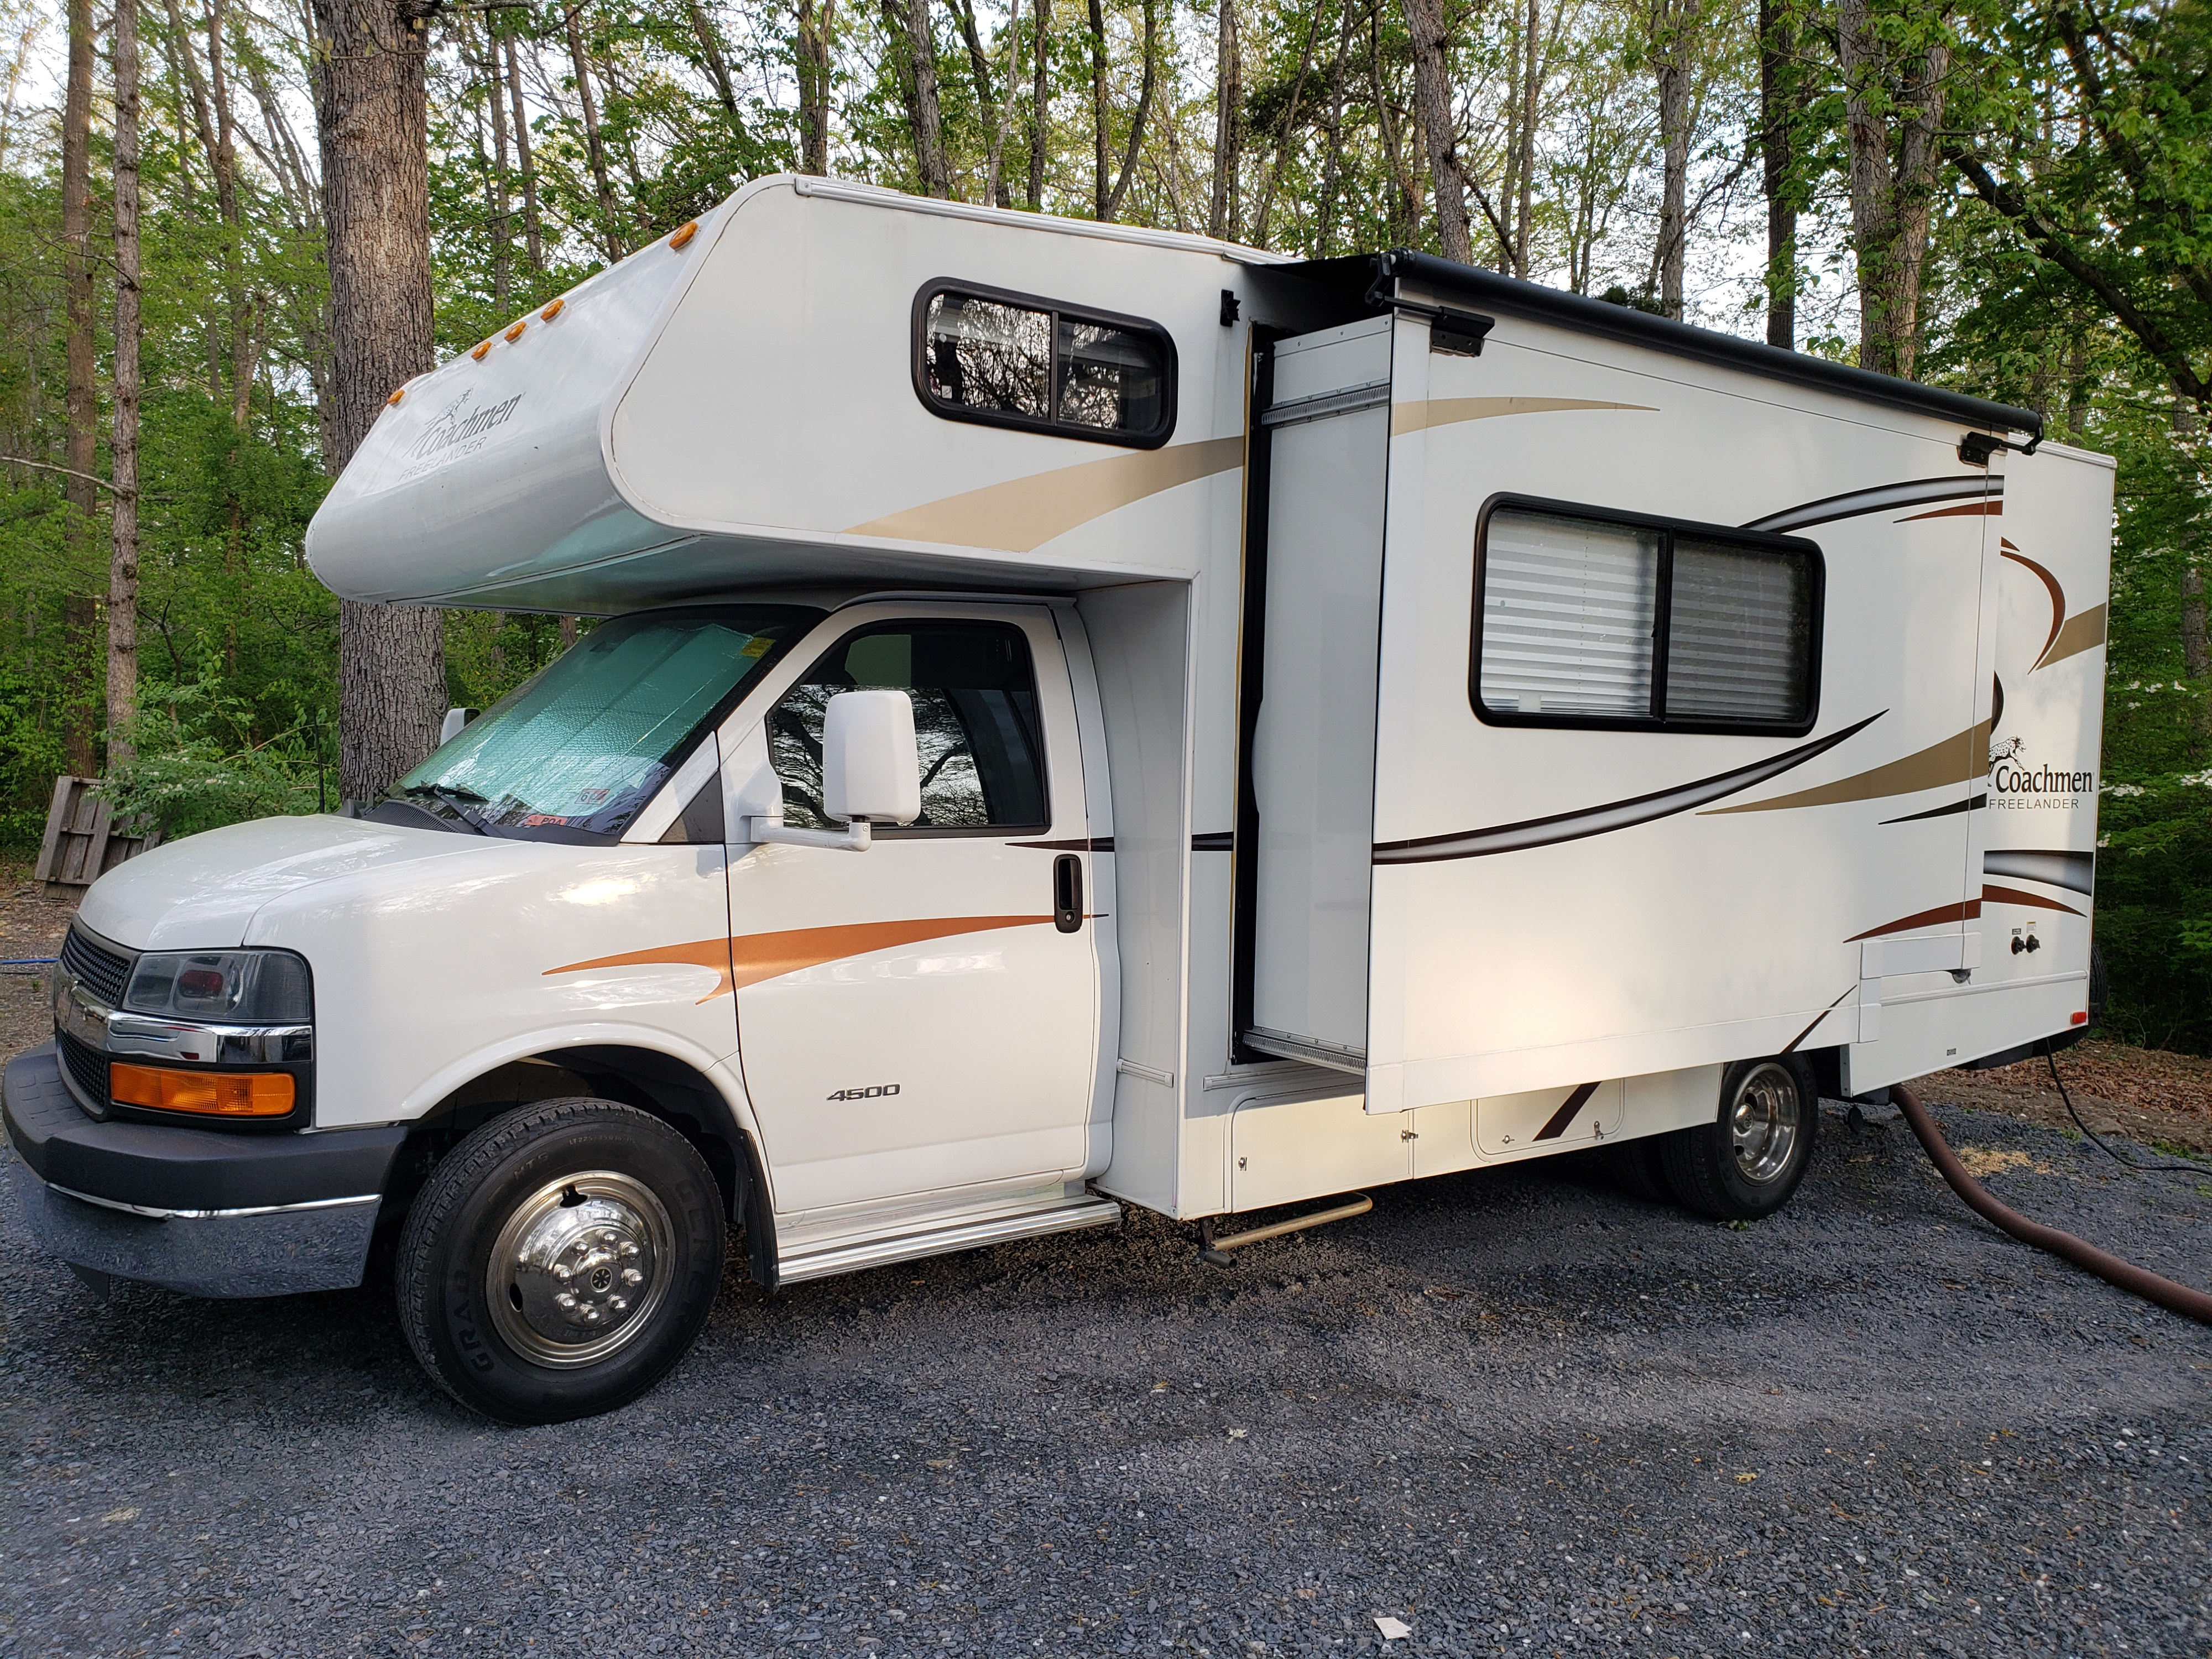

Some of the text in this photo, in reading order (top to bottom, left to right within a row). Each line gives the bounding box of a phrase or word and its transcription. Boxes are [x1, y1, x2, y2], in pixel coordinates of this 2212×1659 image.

[415, 393, 522, 460] Coachmen
[398, 436, 487, 482] FREELANDER
[1995, 763, 2093, 794] Coachmen
[1989, 799, 2079, 810] FREELANDER
[826, 1083, 900, 1102] 4500
